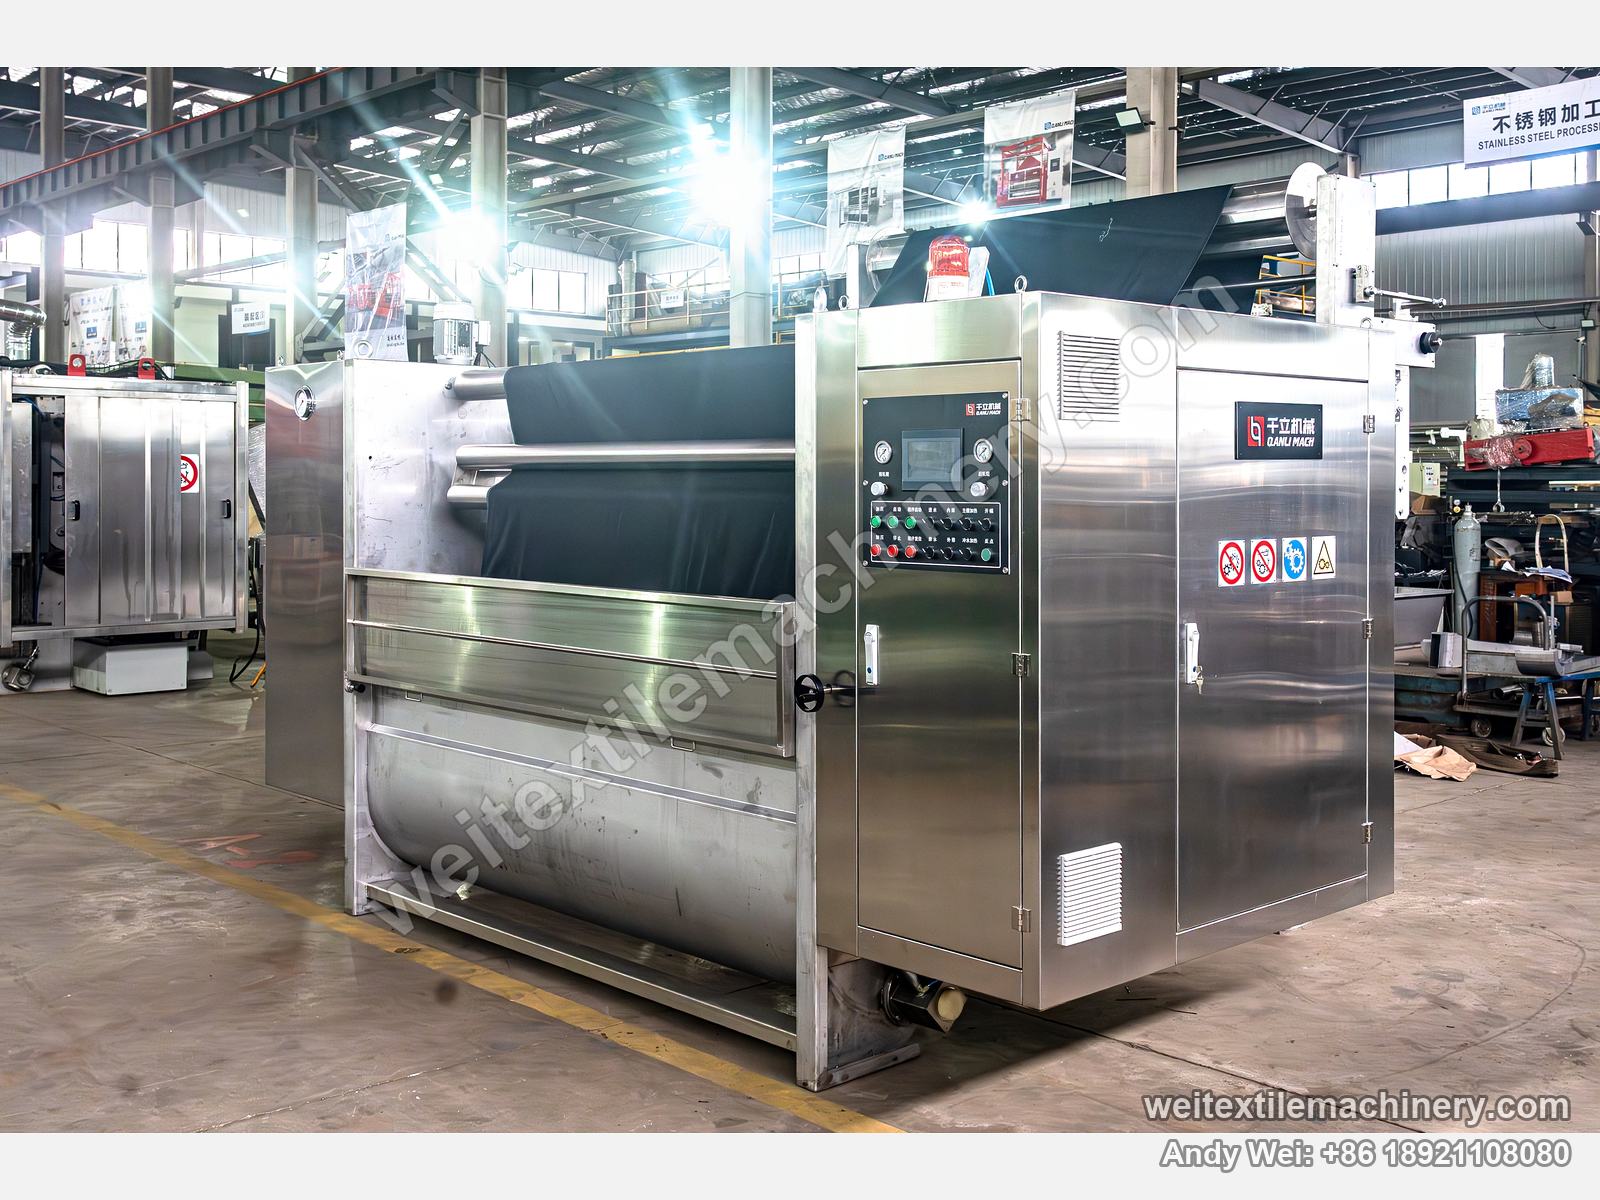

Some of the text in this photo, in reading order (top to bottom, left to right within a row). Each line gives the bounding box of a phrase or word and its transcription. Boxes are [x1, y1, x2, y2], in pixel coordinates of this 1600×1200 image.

[1478, 136, 1526, 150] STAINLESS
[1527, 130, 1555, 143] STEEL
[1267, 417, 1315, 434] 千立机械
[1292, 436, 1315, 447] MACH
